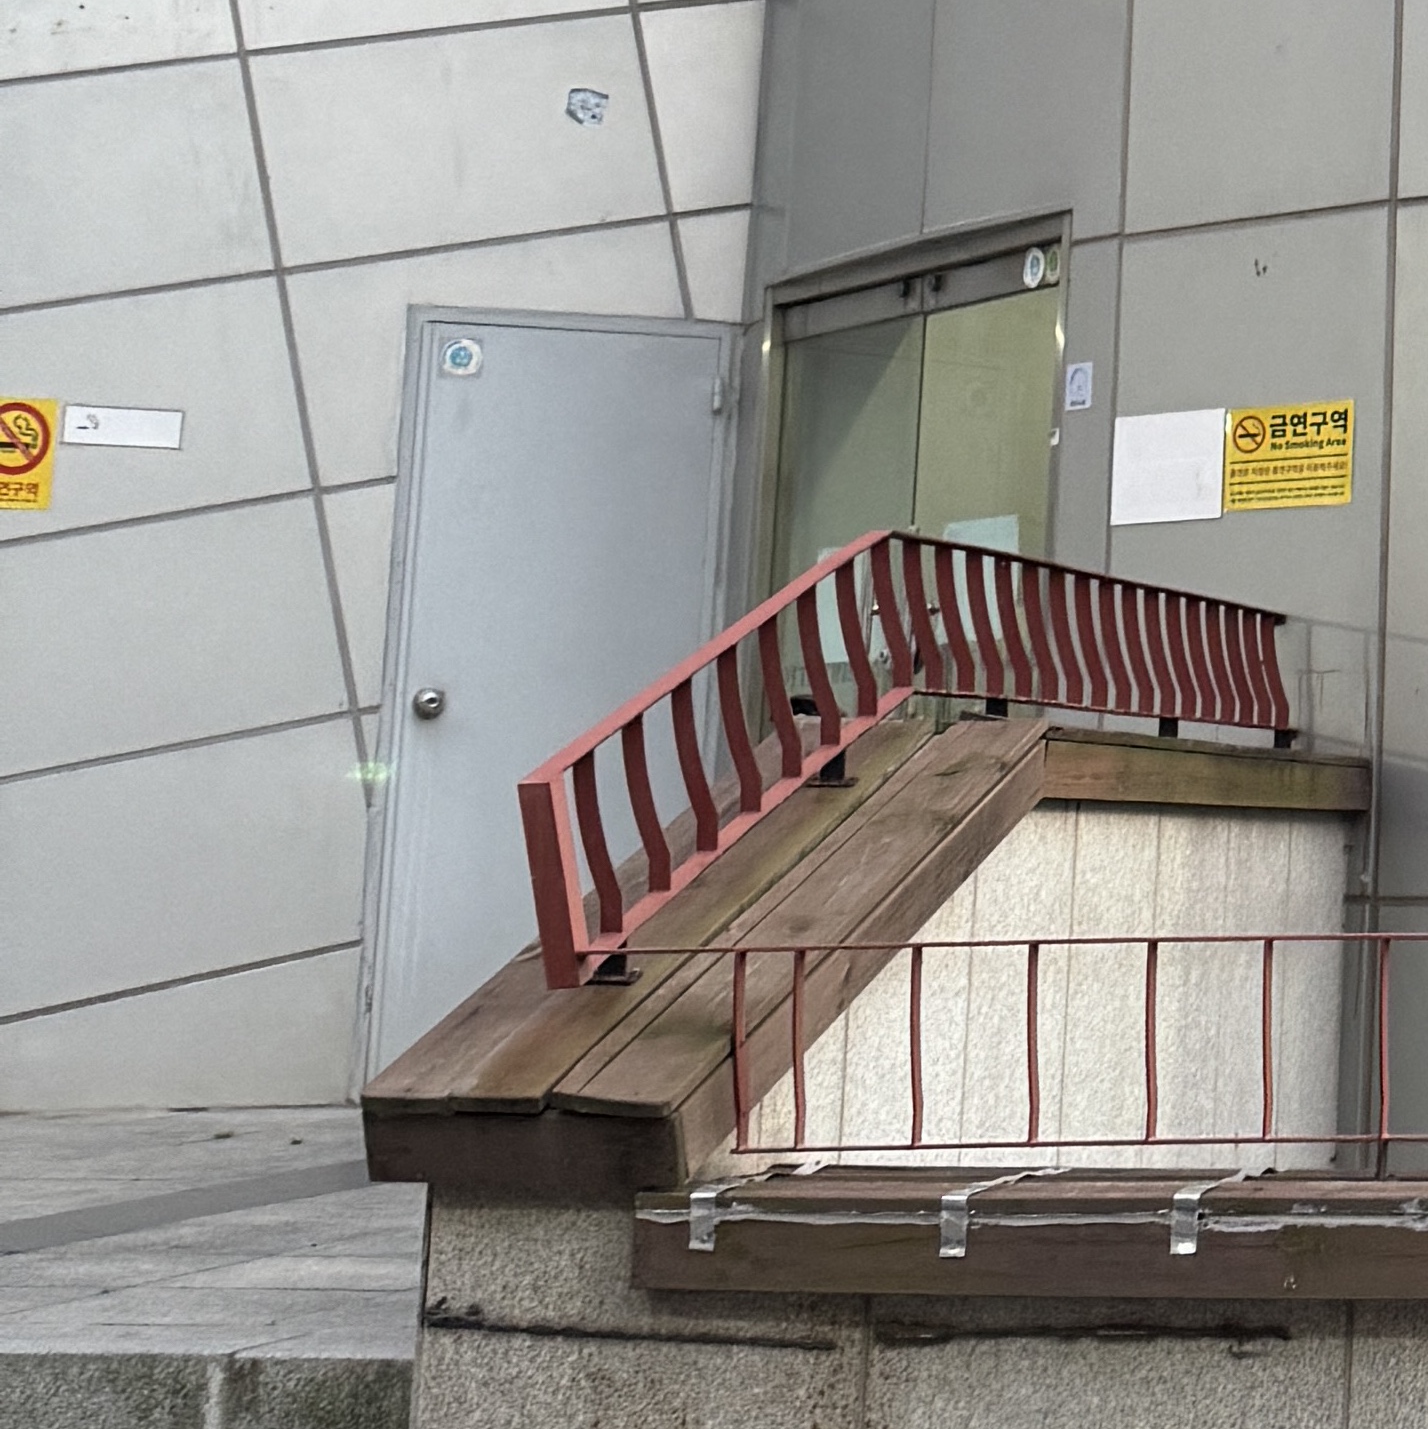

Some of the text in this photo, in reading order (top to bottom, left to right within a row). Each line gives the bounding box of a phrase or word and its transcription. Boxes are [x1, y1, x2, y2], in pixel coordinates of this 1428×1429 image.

[1269, 408, 1349, 440] 금연구역
[1270, 437, 1347, 451] No Smoking Area
